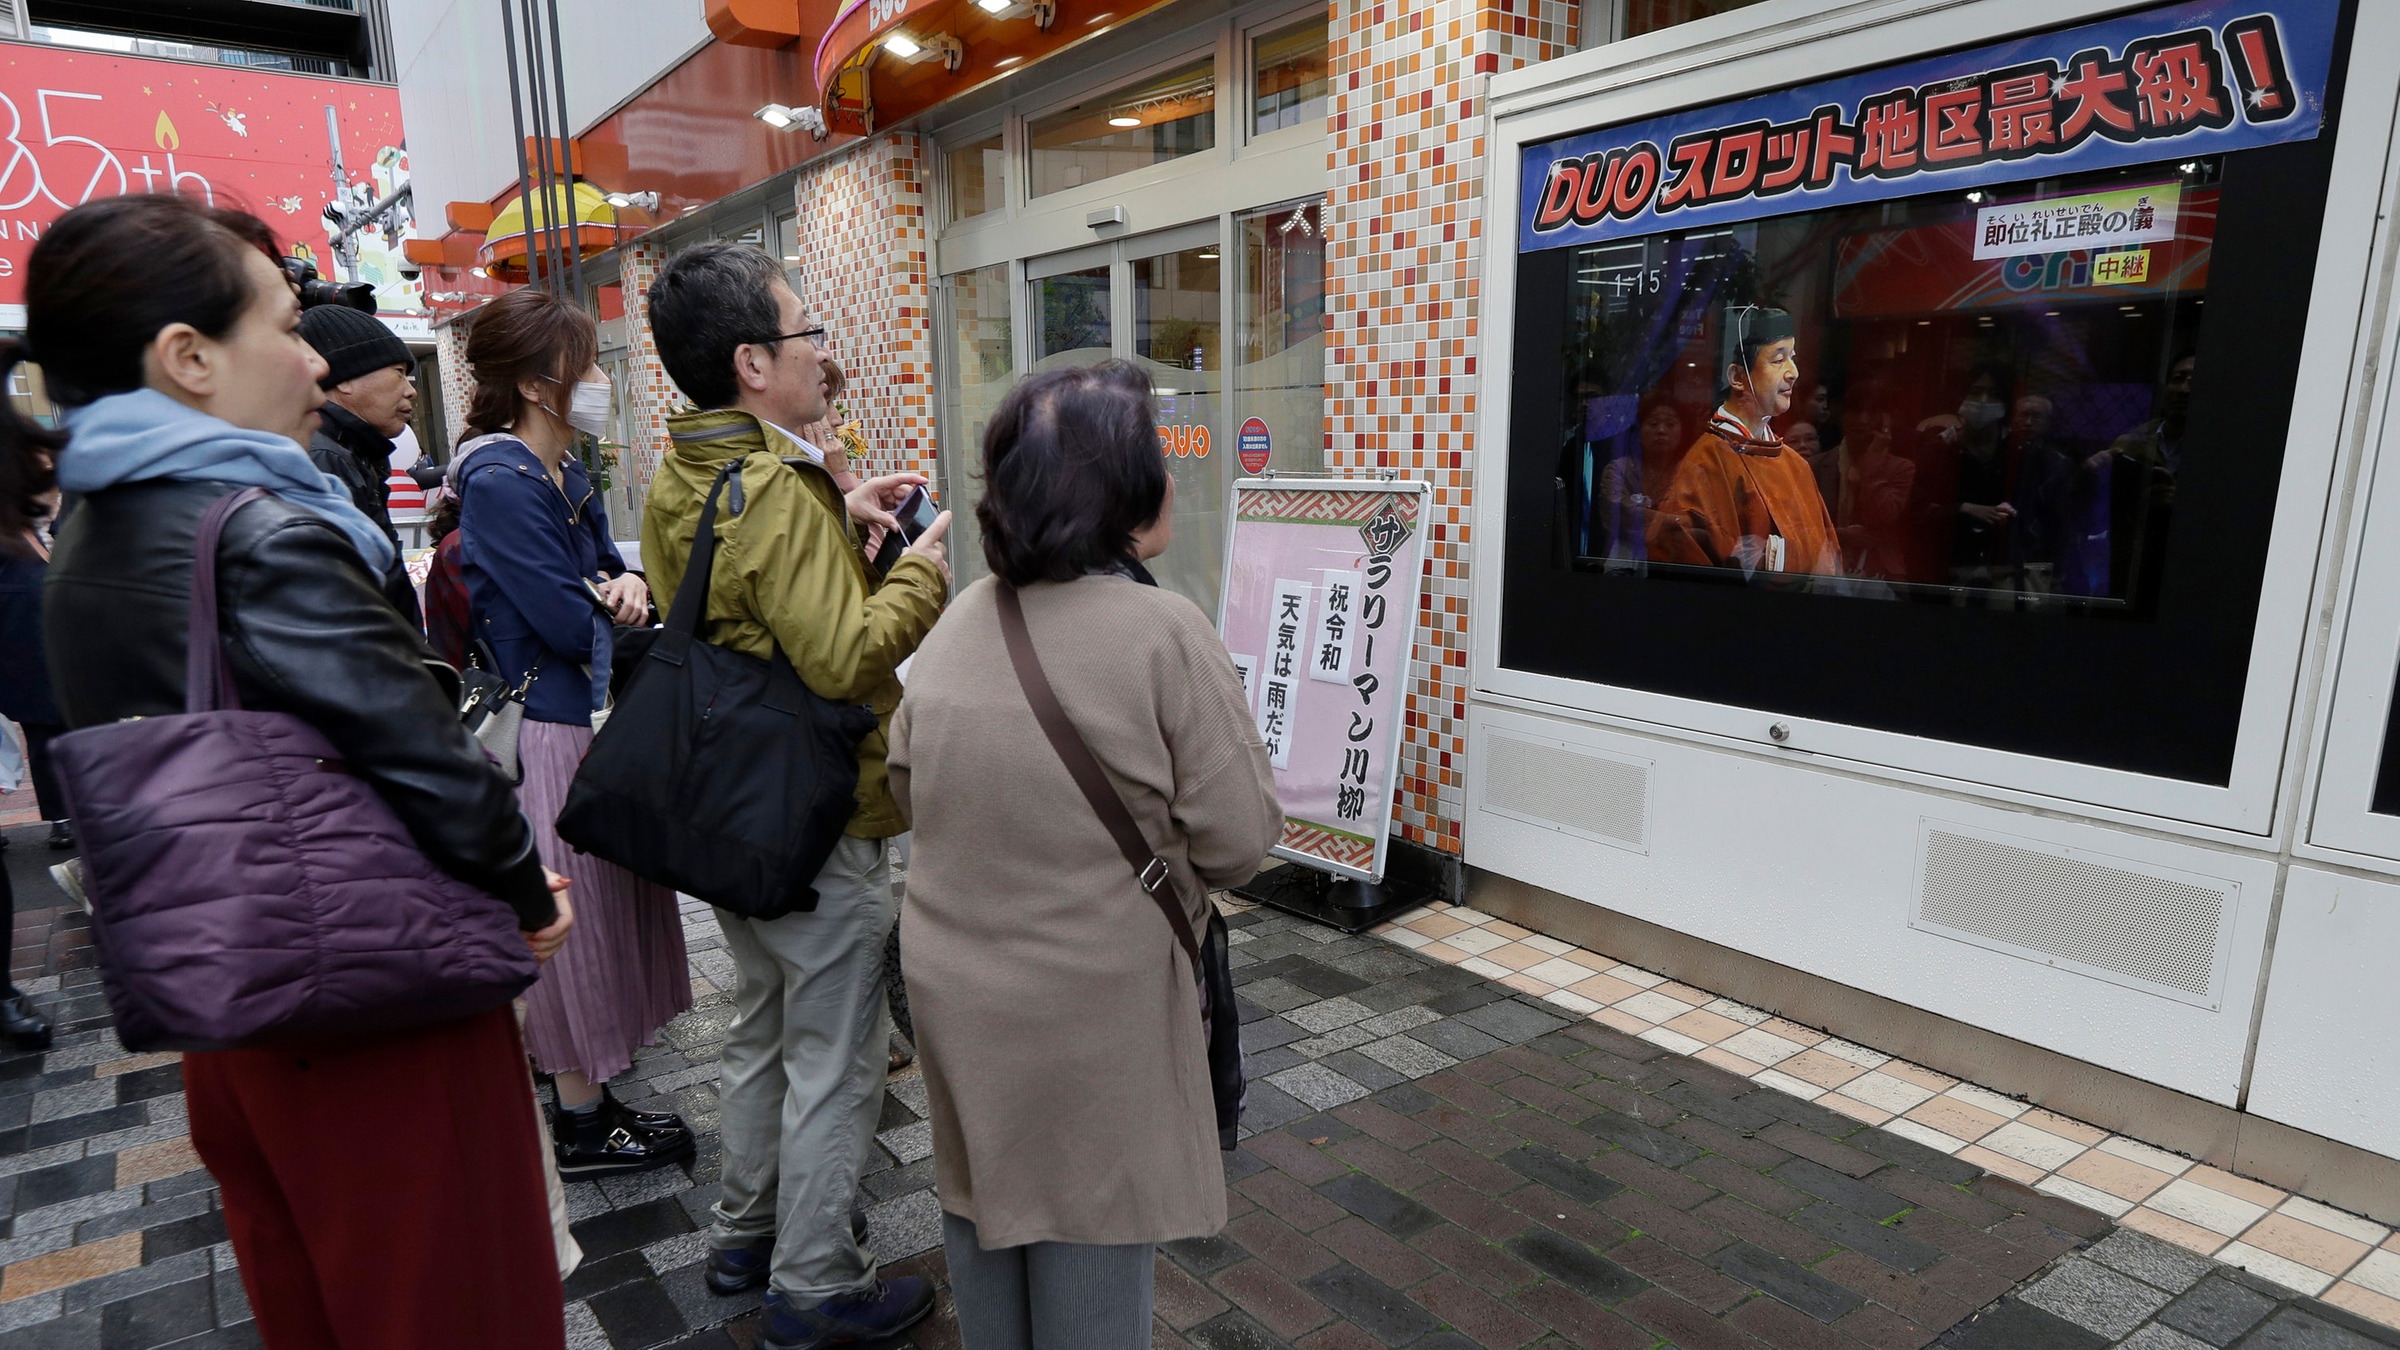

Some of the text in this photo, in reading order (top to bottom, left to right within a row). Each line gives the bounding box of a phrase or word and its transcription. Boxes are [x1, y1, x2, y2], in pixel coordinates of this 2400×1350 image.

[1538, 28, 2282, 226] DUO スロット地区最大級！
[1983, 206, 2155, 246] 即位礼正殿の儀
[1615, 269, 1661, 297] 1:15
[2098, 254, 2145, 280] 中継
[1319, 583, 1350, 671] 祝令和
[1336, 514, 1399, 822] サラリーマン川柳
